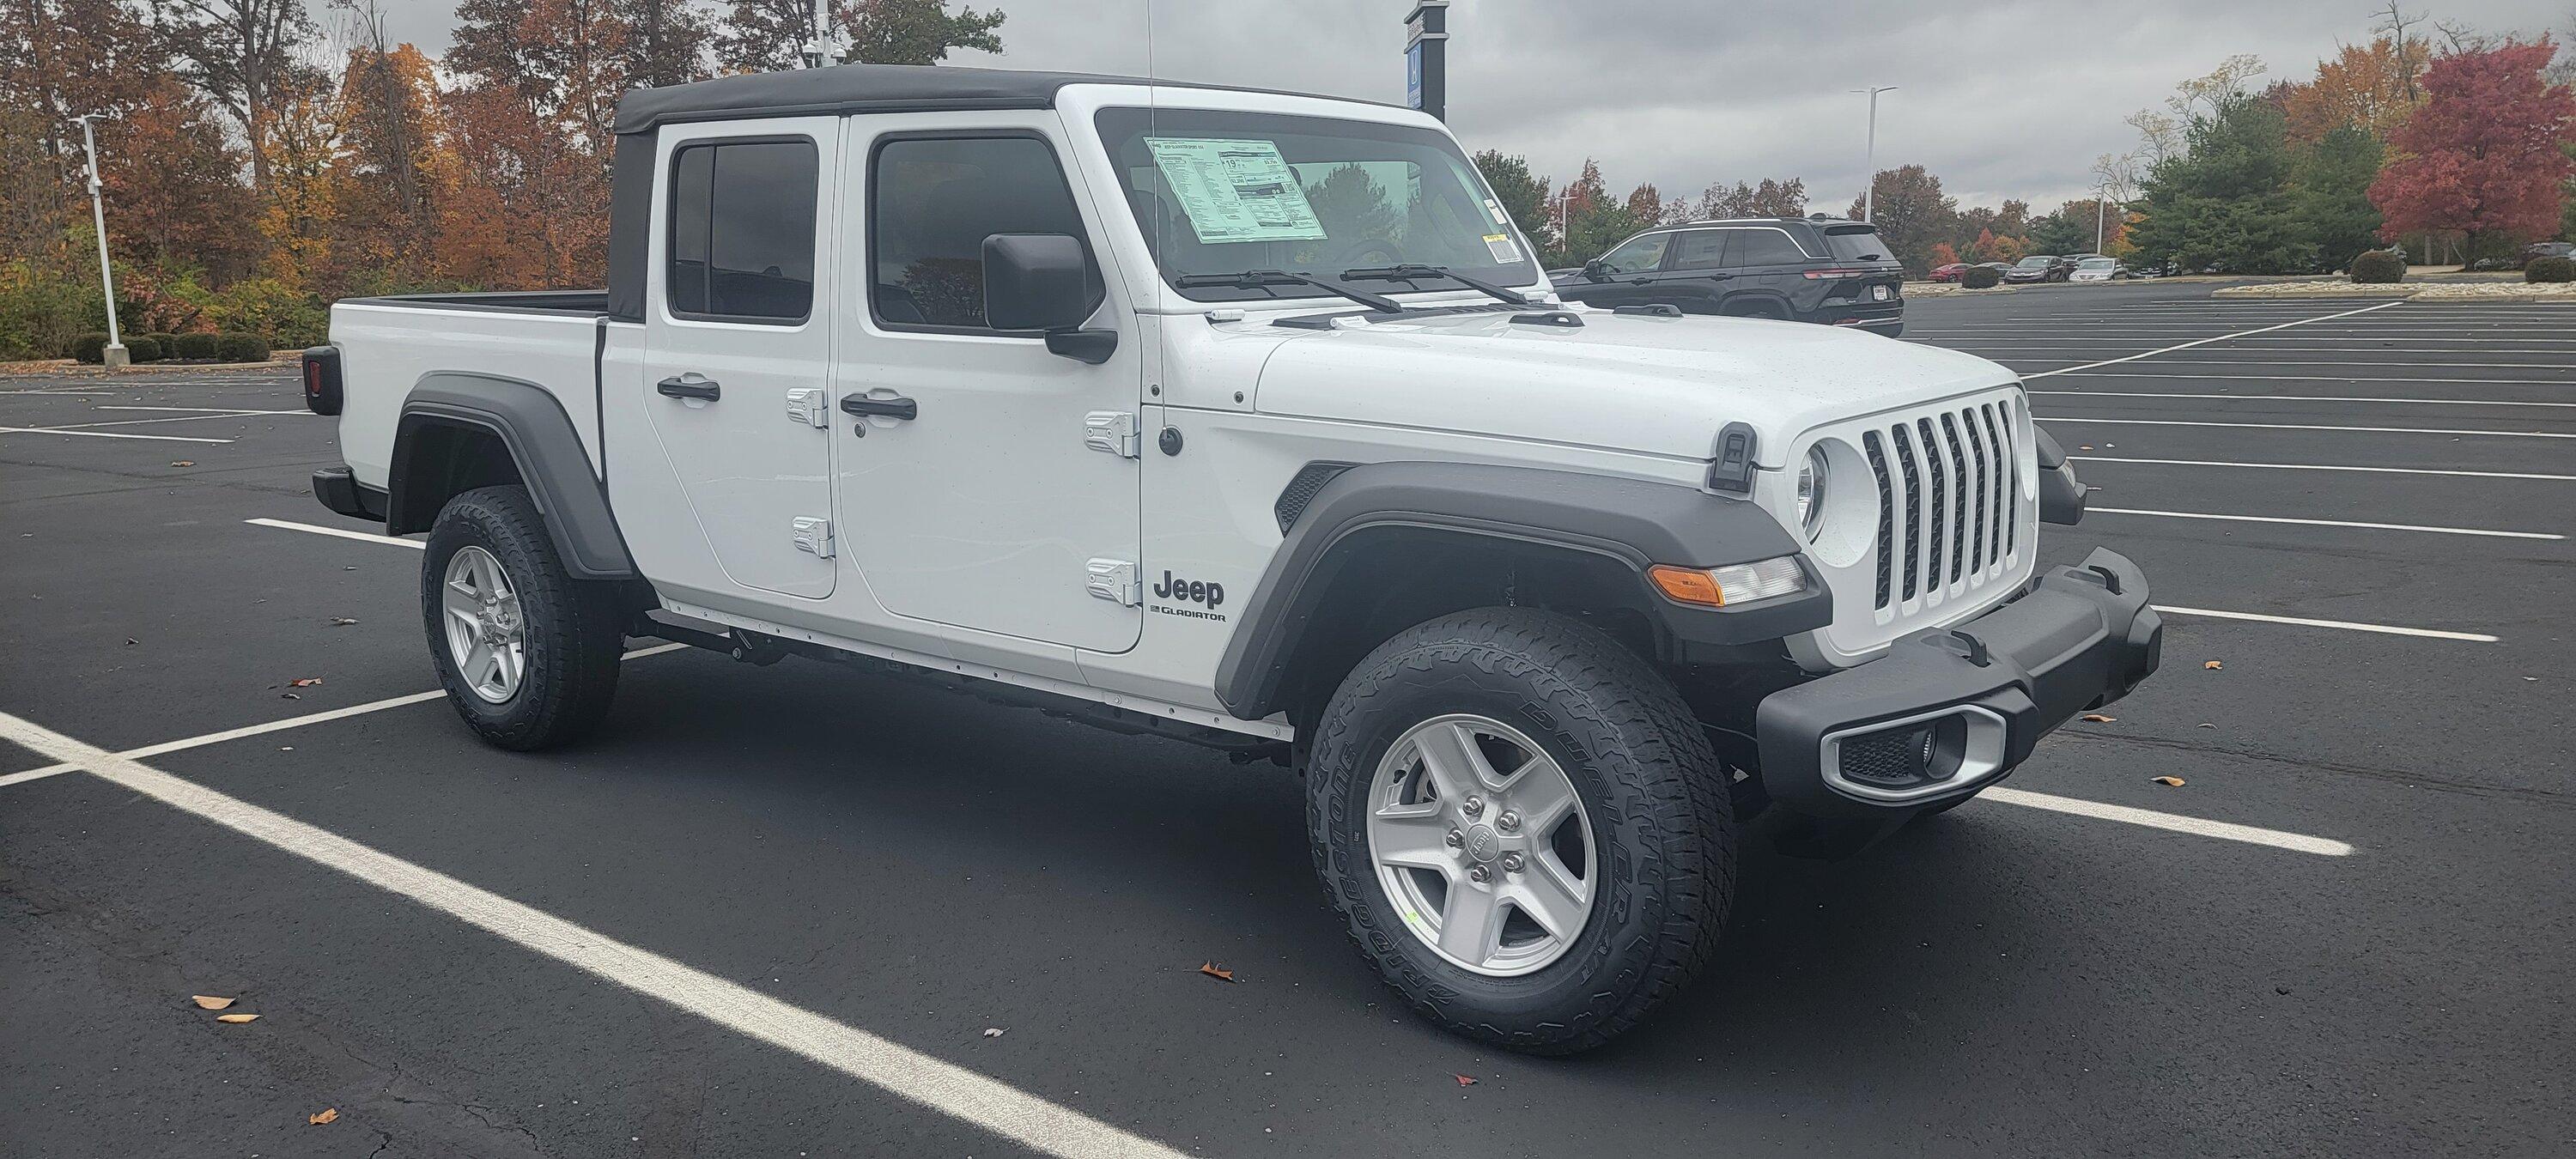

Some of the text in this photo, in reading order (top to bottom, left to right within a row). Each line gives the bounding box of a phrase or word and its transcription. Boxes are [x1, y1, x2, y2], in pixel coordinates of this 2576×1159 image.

[1226, 159, 1236, 168] 19
[1153, 570, 1224, 610] Jeep
[1161, 607, 1226, 622] GLADIATOR
[1520, 700, 1633, 925] DUELER
[1473, 831, 1490, 855] Jeep
[1327, 741, 1461, 1006] BRIDGESTONE
